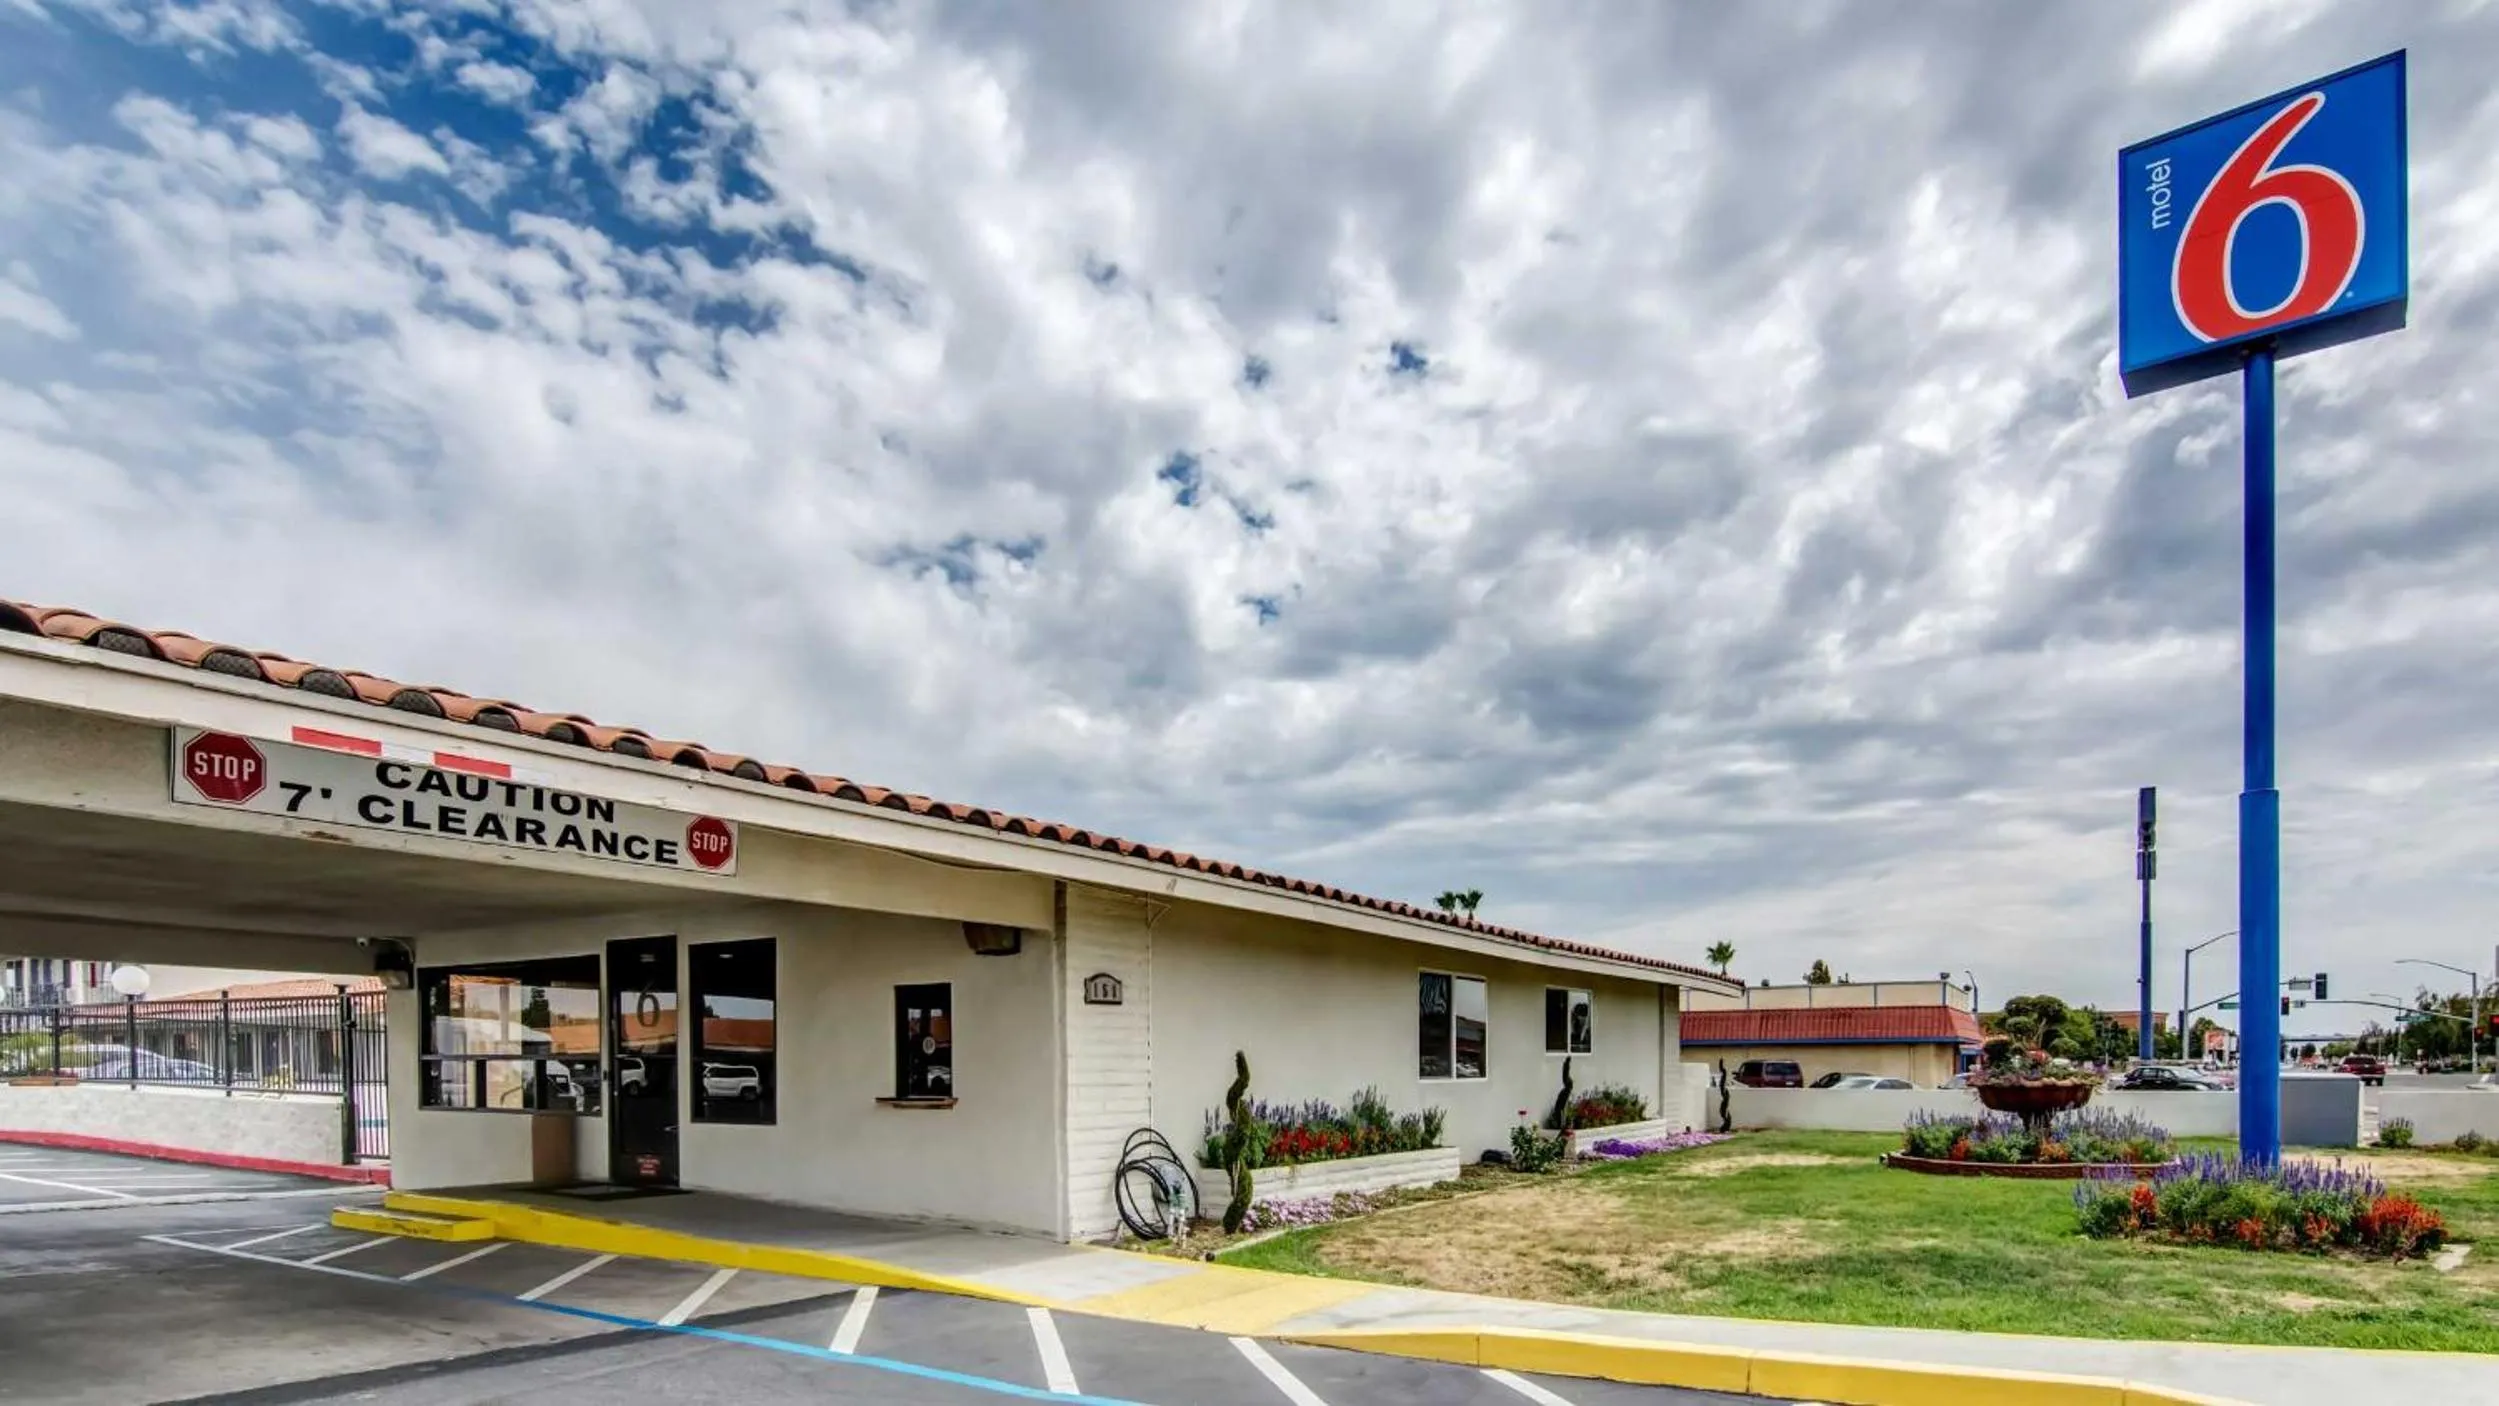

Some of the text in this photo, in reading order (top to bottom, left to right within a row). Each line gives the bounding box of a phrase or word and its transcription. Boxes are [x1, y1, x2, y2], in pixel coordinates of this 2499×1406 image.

[2146, 158, 2171, 230] motel
[2171, 91, 2366, 343] 6
[193, 750, 256, 782] STOP
[376, 762, 614, 823] CAUTION
[280, 781, 678, 865] 7' CLEARANCE
[692, 830, 729, 853] STOP
